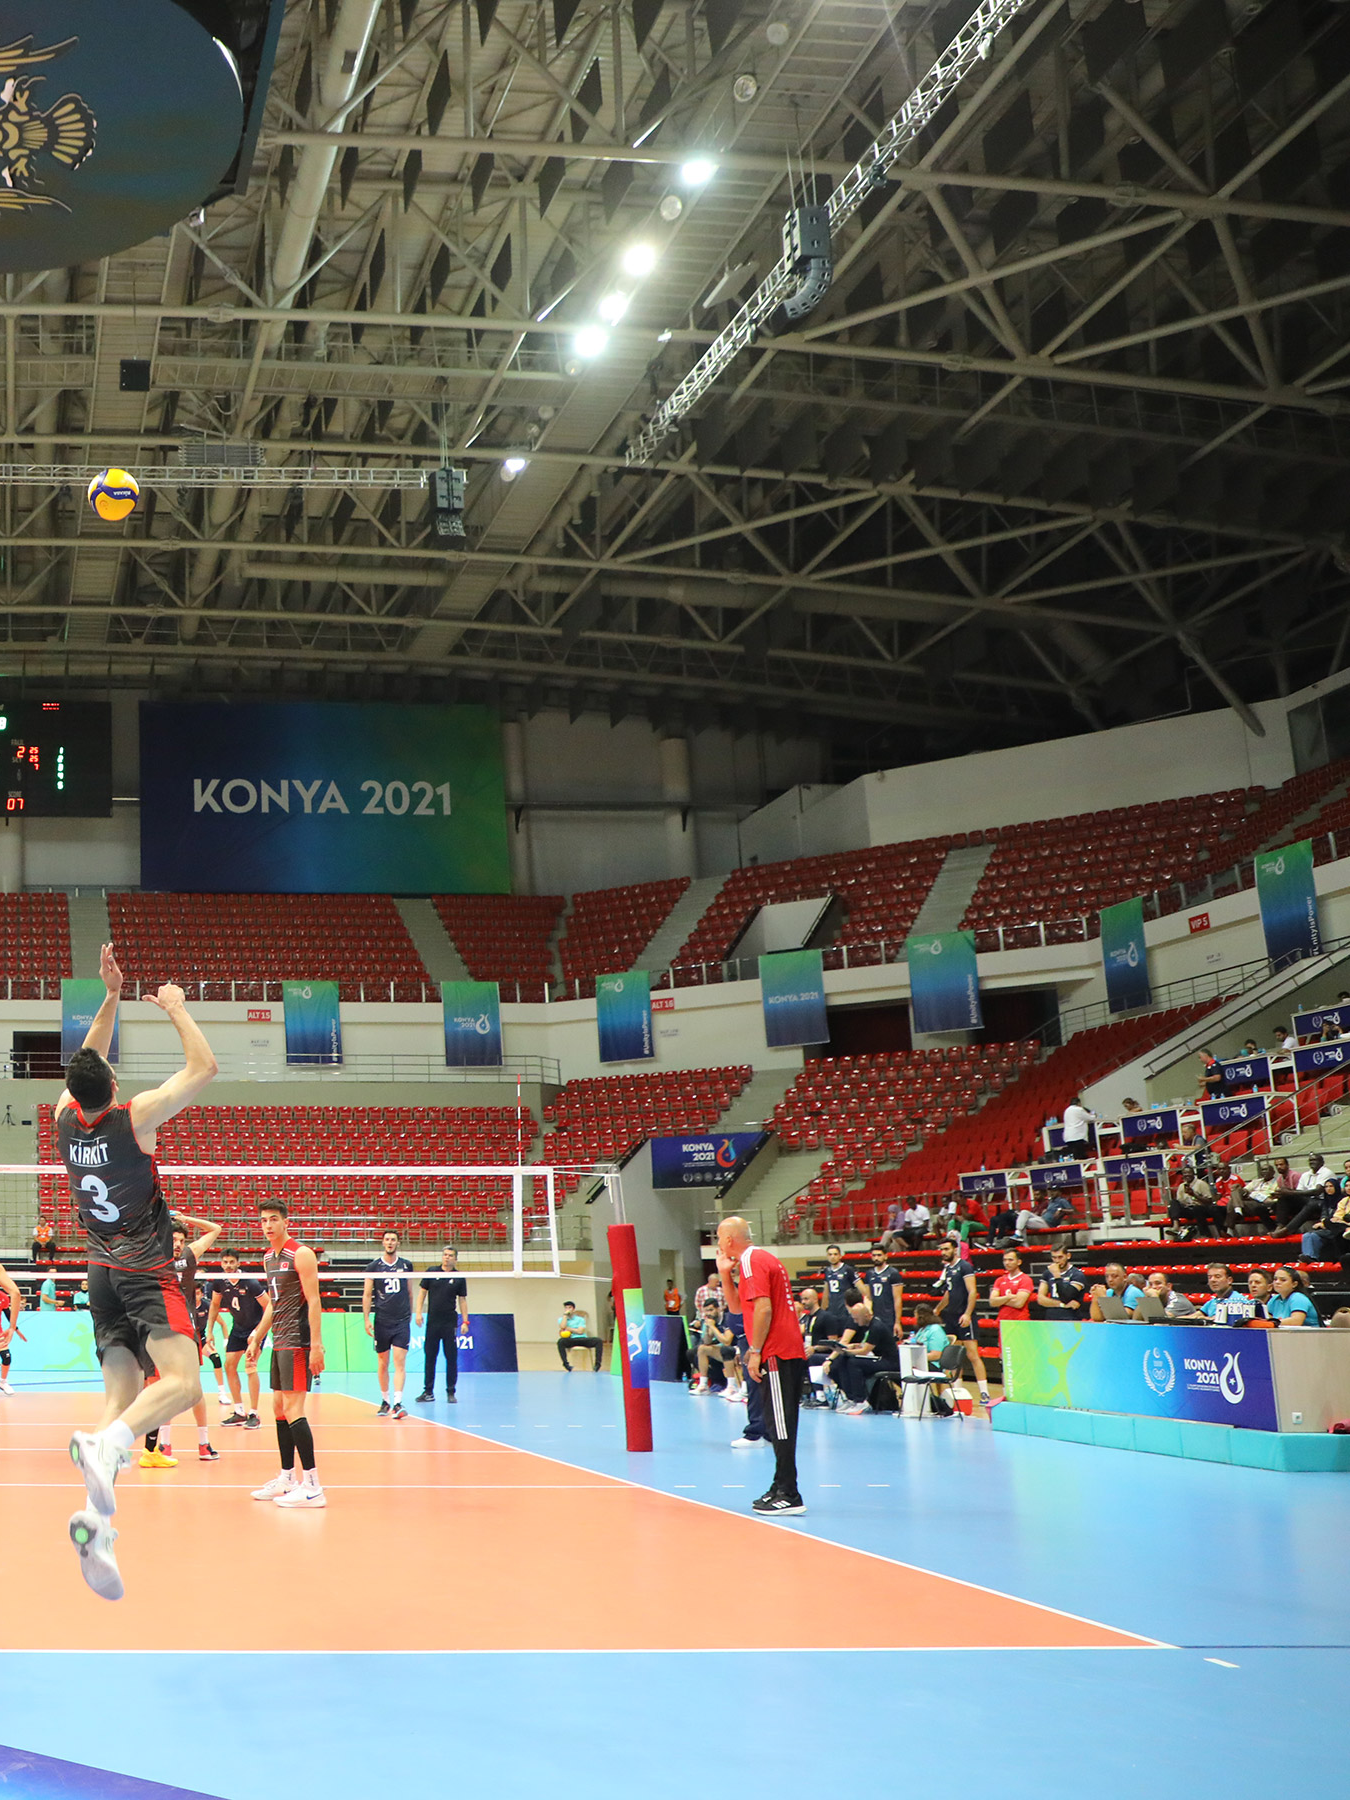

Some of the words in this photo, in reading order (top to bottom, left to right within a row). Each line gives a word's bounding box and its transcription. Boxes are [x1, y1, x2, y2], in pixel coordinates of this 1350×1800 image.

[16, 745, 26, 758] 2
[33, 763, 40, 771] 7
[193, 778, 350, 814] KONYA
[360, 780, 452, 816] 2021
[6, 798, 25, 811] 07
[1190, 919, 1201, 930] VIP
[768, 994, 798, 1004] KONYA
[800, 991, 819, 1001] 2021
[652, 1001, 663, 1009] ALT
[248, 1011, 260, 1019] ALT
[682, 1142, 715, 1152] KONYA
[692, 1152, 715, 1161] 2021
[80, 1174, 121, 1223] 3
[384, 1278, 400, 1294] 20
[829, 1279, 840, 1293] 12
[872, 1283, 884, 1297] 17
[231, 1296, 240, 1311] 4
[1183, 1358, 1218, 1372] KONYA
[1007, 1346, 1015, 1398] volleyball
[1195, 1371, 1220, 1385] 2021
